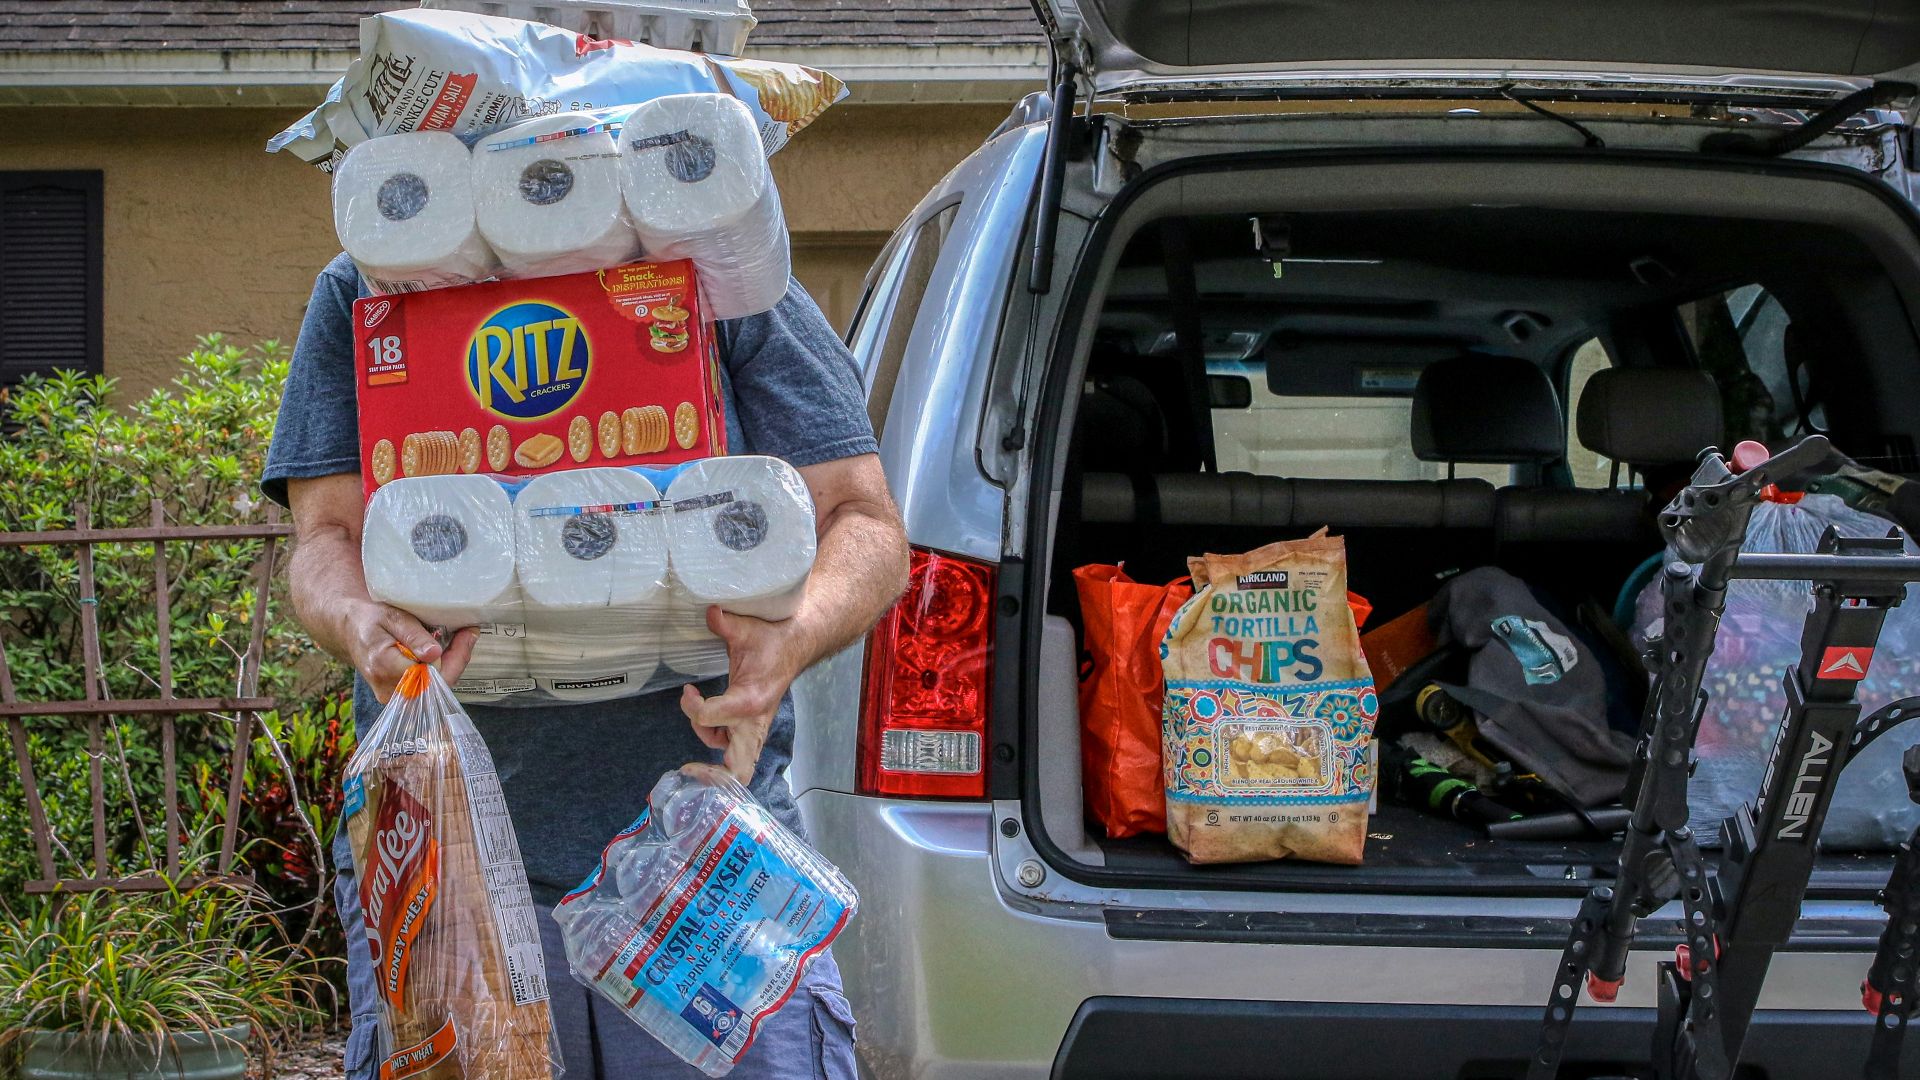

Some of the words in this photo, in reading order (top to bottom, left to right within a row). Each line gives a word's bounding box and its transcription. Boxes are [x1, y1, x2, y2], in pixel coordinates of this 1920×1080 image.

[393, 88, 416, 117] BRAND
[442, 81, 463, 103] SALT
[483, 93, 508, 125] PROMISE
[613, 275, 685, 292] INSPIRATIONS!
[623, 271, 654, 282] Snack
[366, 302, 388, 326] NABISCO
[368, 335, 402, 365] 18
[475, 317, 582, 410] RITZ
[530, 382, 571, 398] CRACKERS
[1239, 572, 1287, 583] KIRKLAND
[1211, 589, 1317, 614] ORGANIC
[1211, 615, 1319, 638] TORTILLA
[1208, 637, 1323, 683] CHIPS
[557, 677, 622, 690] KIRKLAND
[1777, 730, 1833, 839] ALLEN
[376, 810, 425, 888] Lee
[644, 919, 672, 957] BOTTLED
[673, 904, 683, 918] AT
[683, 885, 697, 903] THE
[698, 849, 722, 884] SOURCE
[645, 915, 706, 986] CRYSTAL
[696, 844, 756, 917] GEYSER
[388, 935, 408, 993] HONEY
[399, 885, 430, 937] WHEAT
[675, 953, 713, 998] ALPINE
[708, 910, 743, 955] SPRING
[739, 870, 770, 912] WATER
[686, 892, 743, 965] NATURAL
[720, 954, 728, 963] BY
[725, 945, 735, 956] CG
[508, 955, 522, 1002] Nutrition
[517, 972, 527, 1001] Facts
[692, 995, 713, 1016] 6
